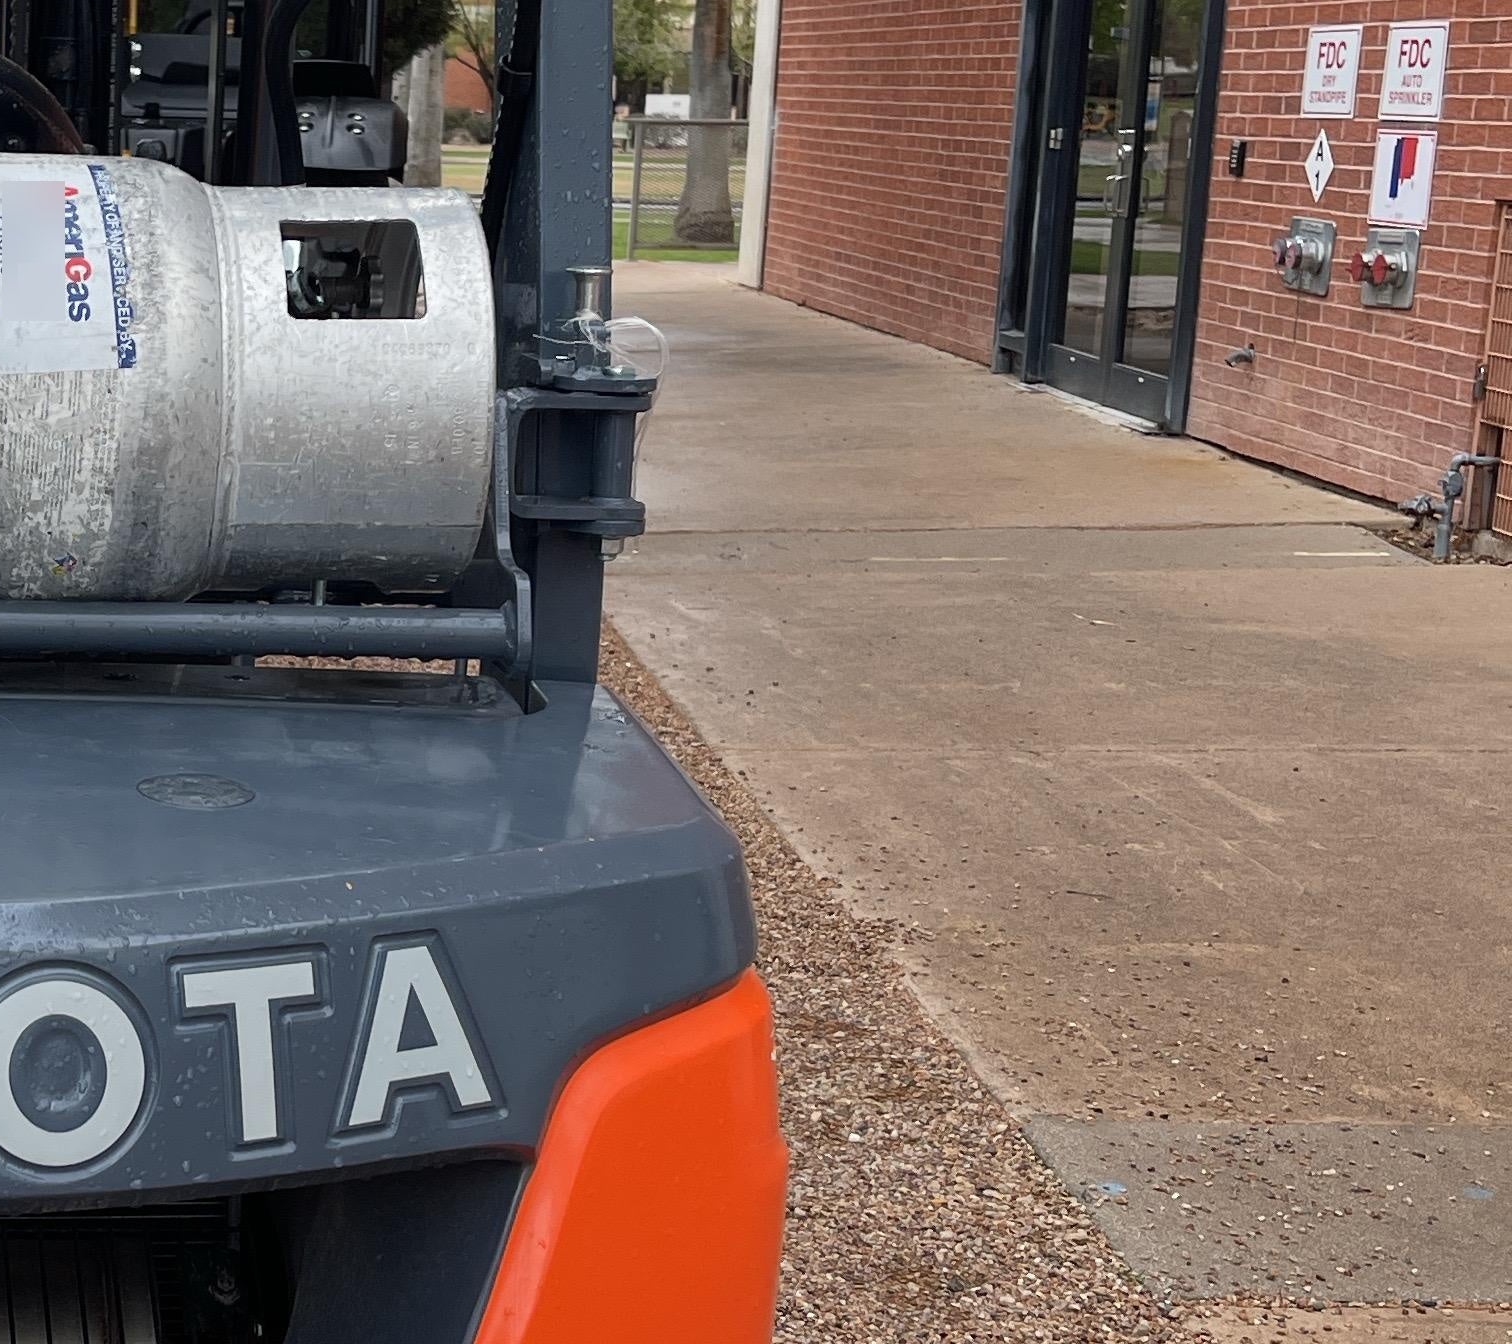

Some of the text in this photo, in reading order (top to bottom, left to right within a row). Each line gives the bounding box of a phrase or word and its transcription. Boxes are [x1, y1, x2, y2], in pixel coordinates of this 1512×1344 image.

[1317, 39, 1348, 70] FDC
[1398, 38, 1433, 69] FDC
[1400, 74, 1423, 88] AUTO
[1308, 90, 1348, 105] STANDPIPE
[1388, 91, 1433, 106] SPRINKLER
[1314, 140, 1324, 162] A
[1314, 170, 1320, 191] 1
